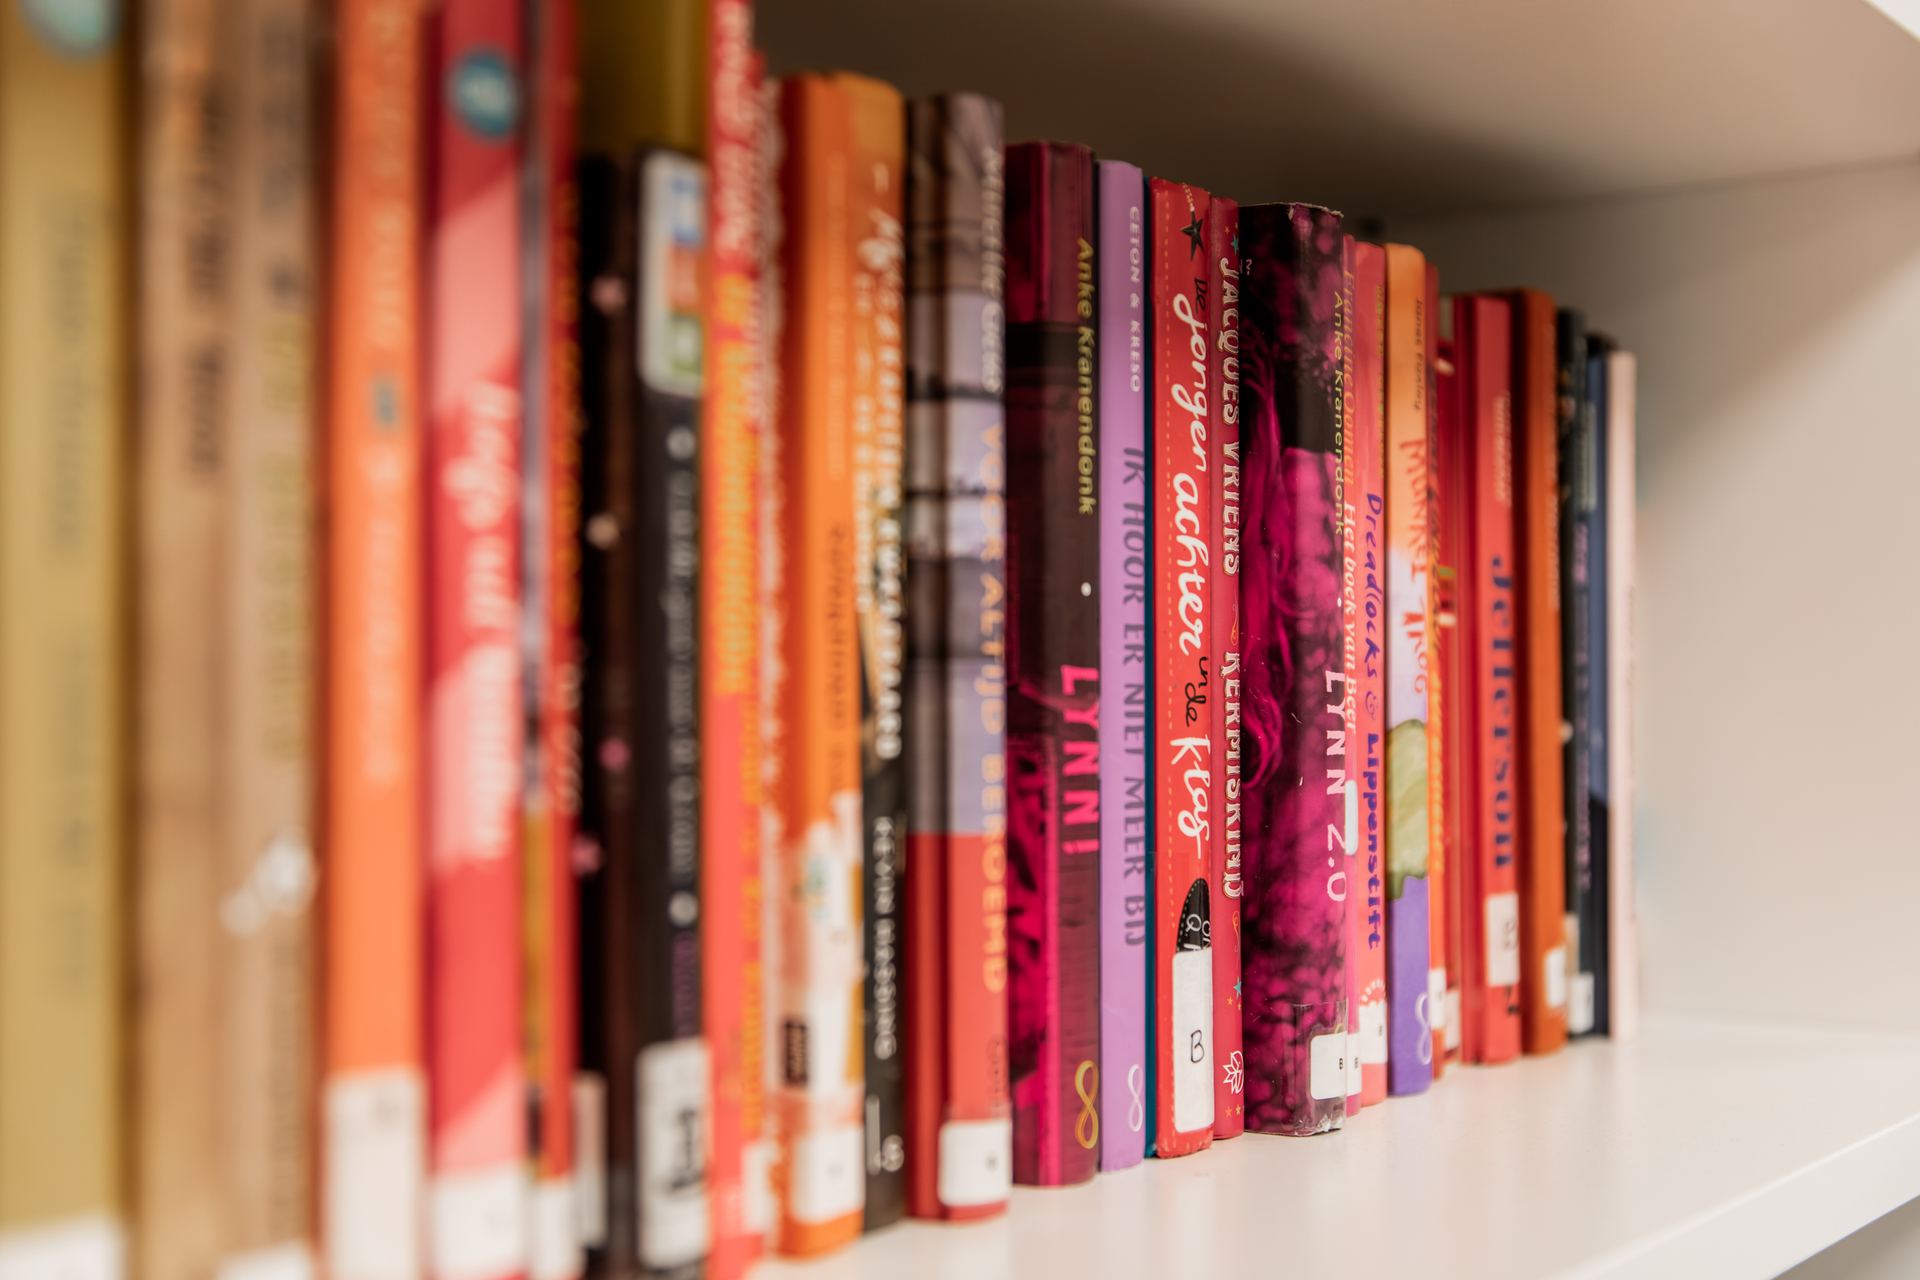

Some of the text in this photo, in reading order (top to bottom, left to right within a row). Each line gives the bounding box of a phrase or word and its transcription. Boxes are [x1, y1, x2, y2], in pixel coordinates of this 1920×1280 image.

[1130, 206, 1141, 283] CETON
[1194, 277, 1208, 314] De
[1077, 238, 1097, 514] Anke Kranendonk
[1171, 293, 1208, 470] jongen
[1217, 257, 1240, 576] JACQUES VRIENS
[1335, 291, 1345, 535] Anke Kranendonk
[1343, 270, 1355, 486] Francine Oomen
[1172, 471, 1209, 654] achter
[1344, 500, 1357, 734] Het boek van Beer
[1364, 492, 1383, 678] Dreadlocks
[975, 423, 1006, 994] VOOR ALTIJD BEROEMD
[1060, 664, 1101, 854] LYNN!
[1123, 447, 1145, 946] IK HOOR ER NIET MEER BIJ
[1185, 682, 1207, 725] de
[1198, 656, 1209, 686] in
[1219, 651, 1241, 898] KERMISKIND
[1325, 670, 1347, 902] LYNN 2.0
[1190, 1029, 1206, 1063] B
